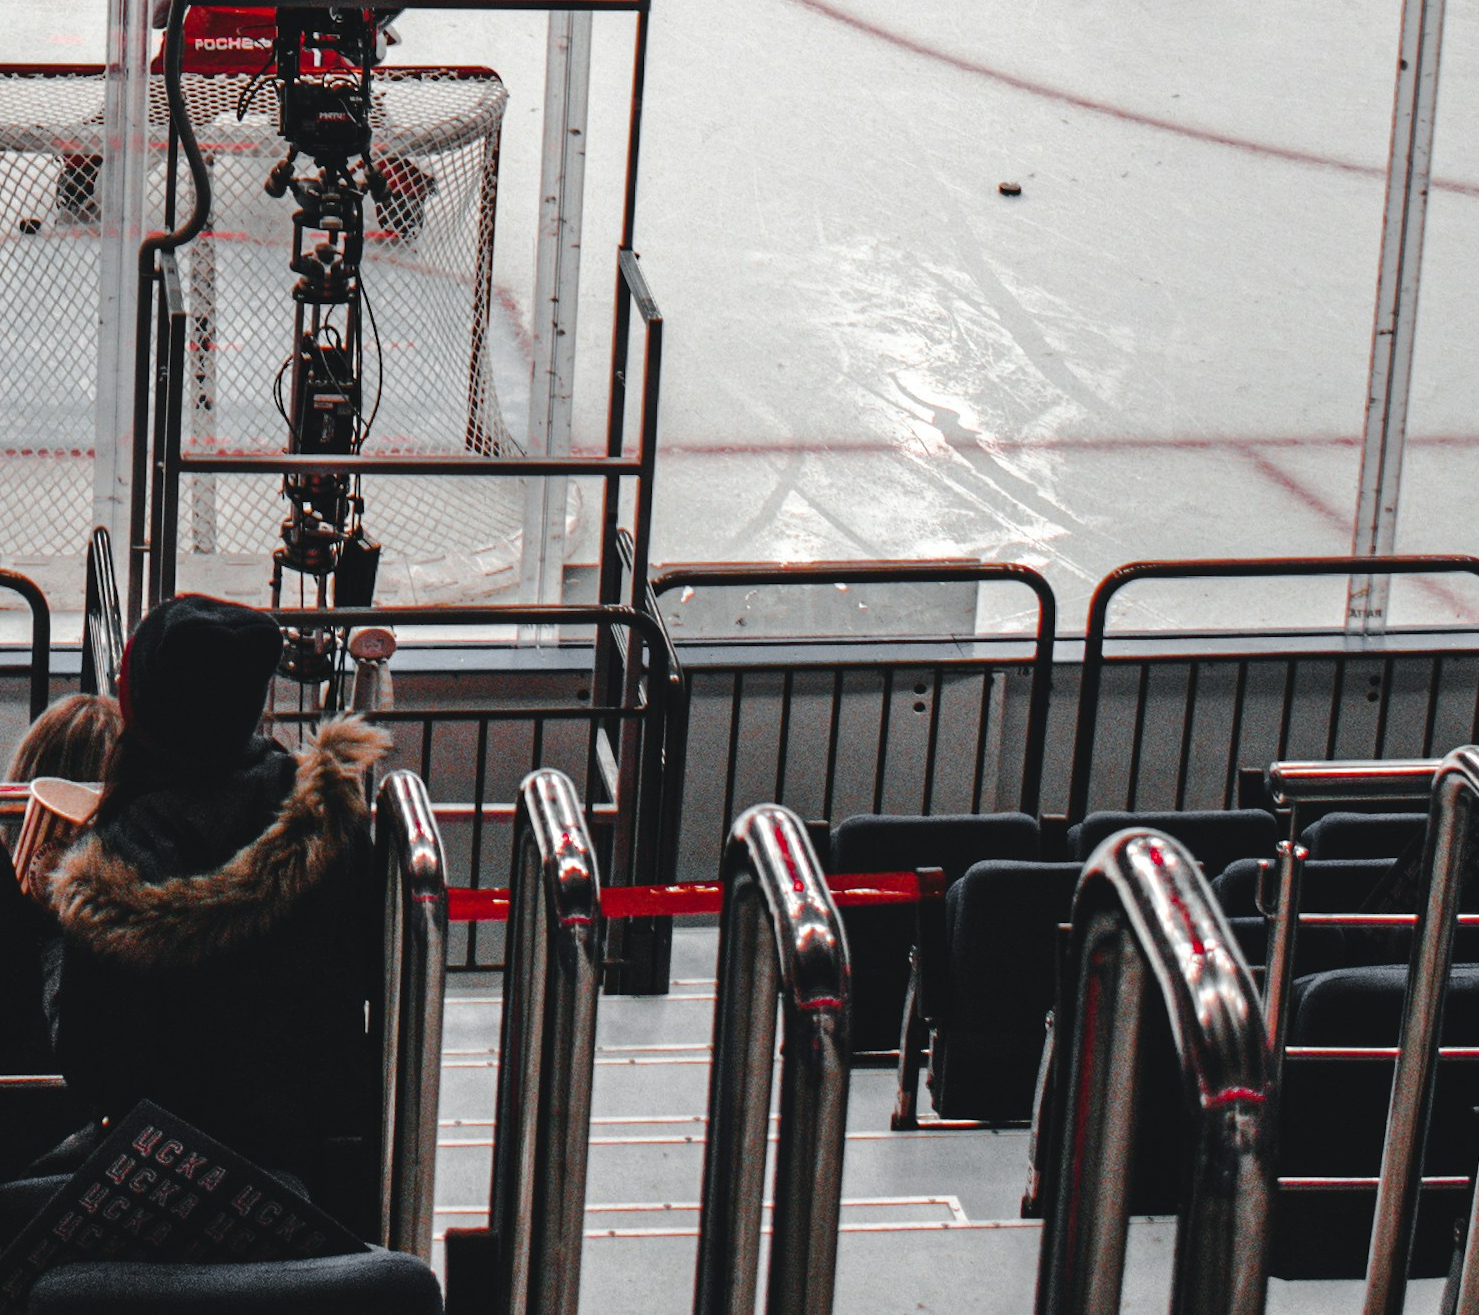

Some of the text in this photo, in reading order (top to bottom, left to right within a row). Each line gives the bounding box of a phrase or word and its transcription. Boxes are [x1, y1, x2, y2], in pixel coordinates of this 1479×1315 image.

[194, 37, 273, 52] РОСНЕФ
[103, 1152, 202, 1221] ЦСКА
[131, 1124, 229, 1194] ЦСКА
[76, 1181, 175, 1248] ЦСКА
[231, 1183, 327, 1257] ЦСКА
